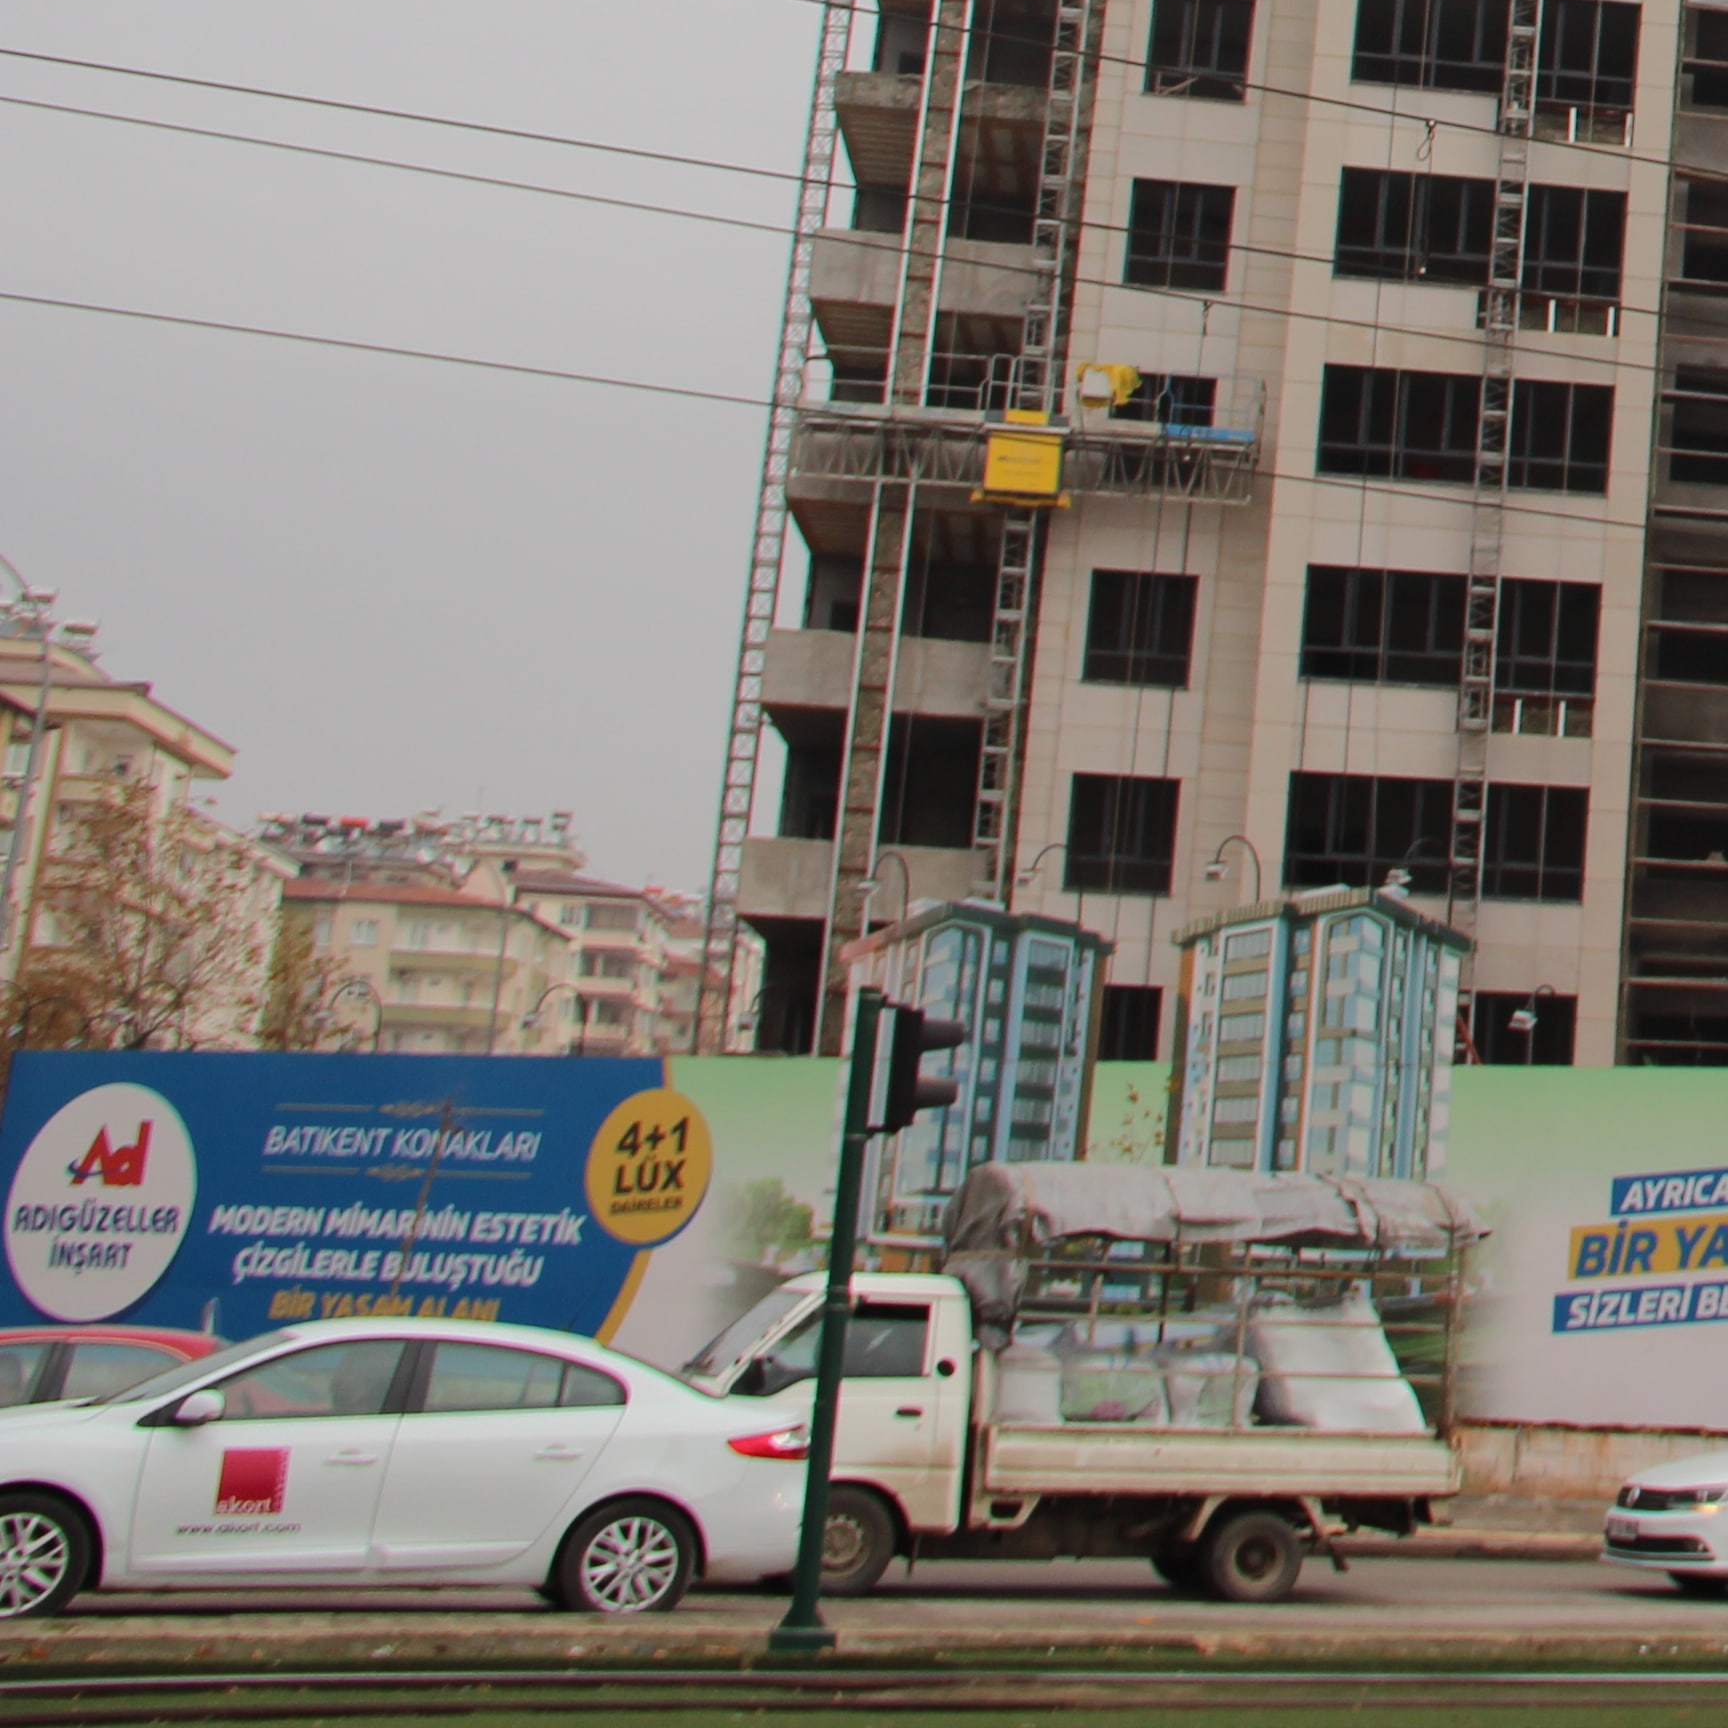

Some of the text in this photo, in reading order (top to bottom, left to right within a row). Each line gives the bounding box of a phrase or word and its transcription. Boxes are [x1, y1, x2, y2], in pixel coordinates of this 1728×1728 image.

[263, 1125, 392, 1156] BATIKENT
[615, 1117, 690, 1158] 4+1
[614, 1154, 687, 1195] LÜX
[13, 1197, 180, 1234] ADIGÜZELLER
[208, 1204, 326, 1236] MODERN
[469, 1208, 588, 1246] ESTETİK
[49, 1235, 133, 1276] İNŞAAT
[233, 1240, 545, 1292] ÇİZGİLERLE BULUŞTUĞU
[1574, 1217, 1659, 1280] BİR
[268, 1283, 317, 1320] BİR
[1565, 1283, 1696, 1329] SİZLERİ
[214, 1495, 272, 1515] akort
